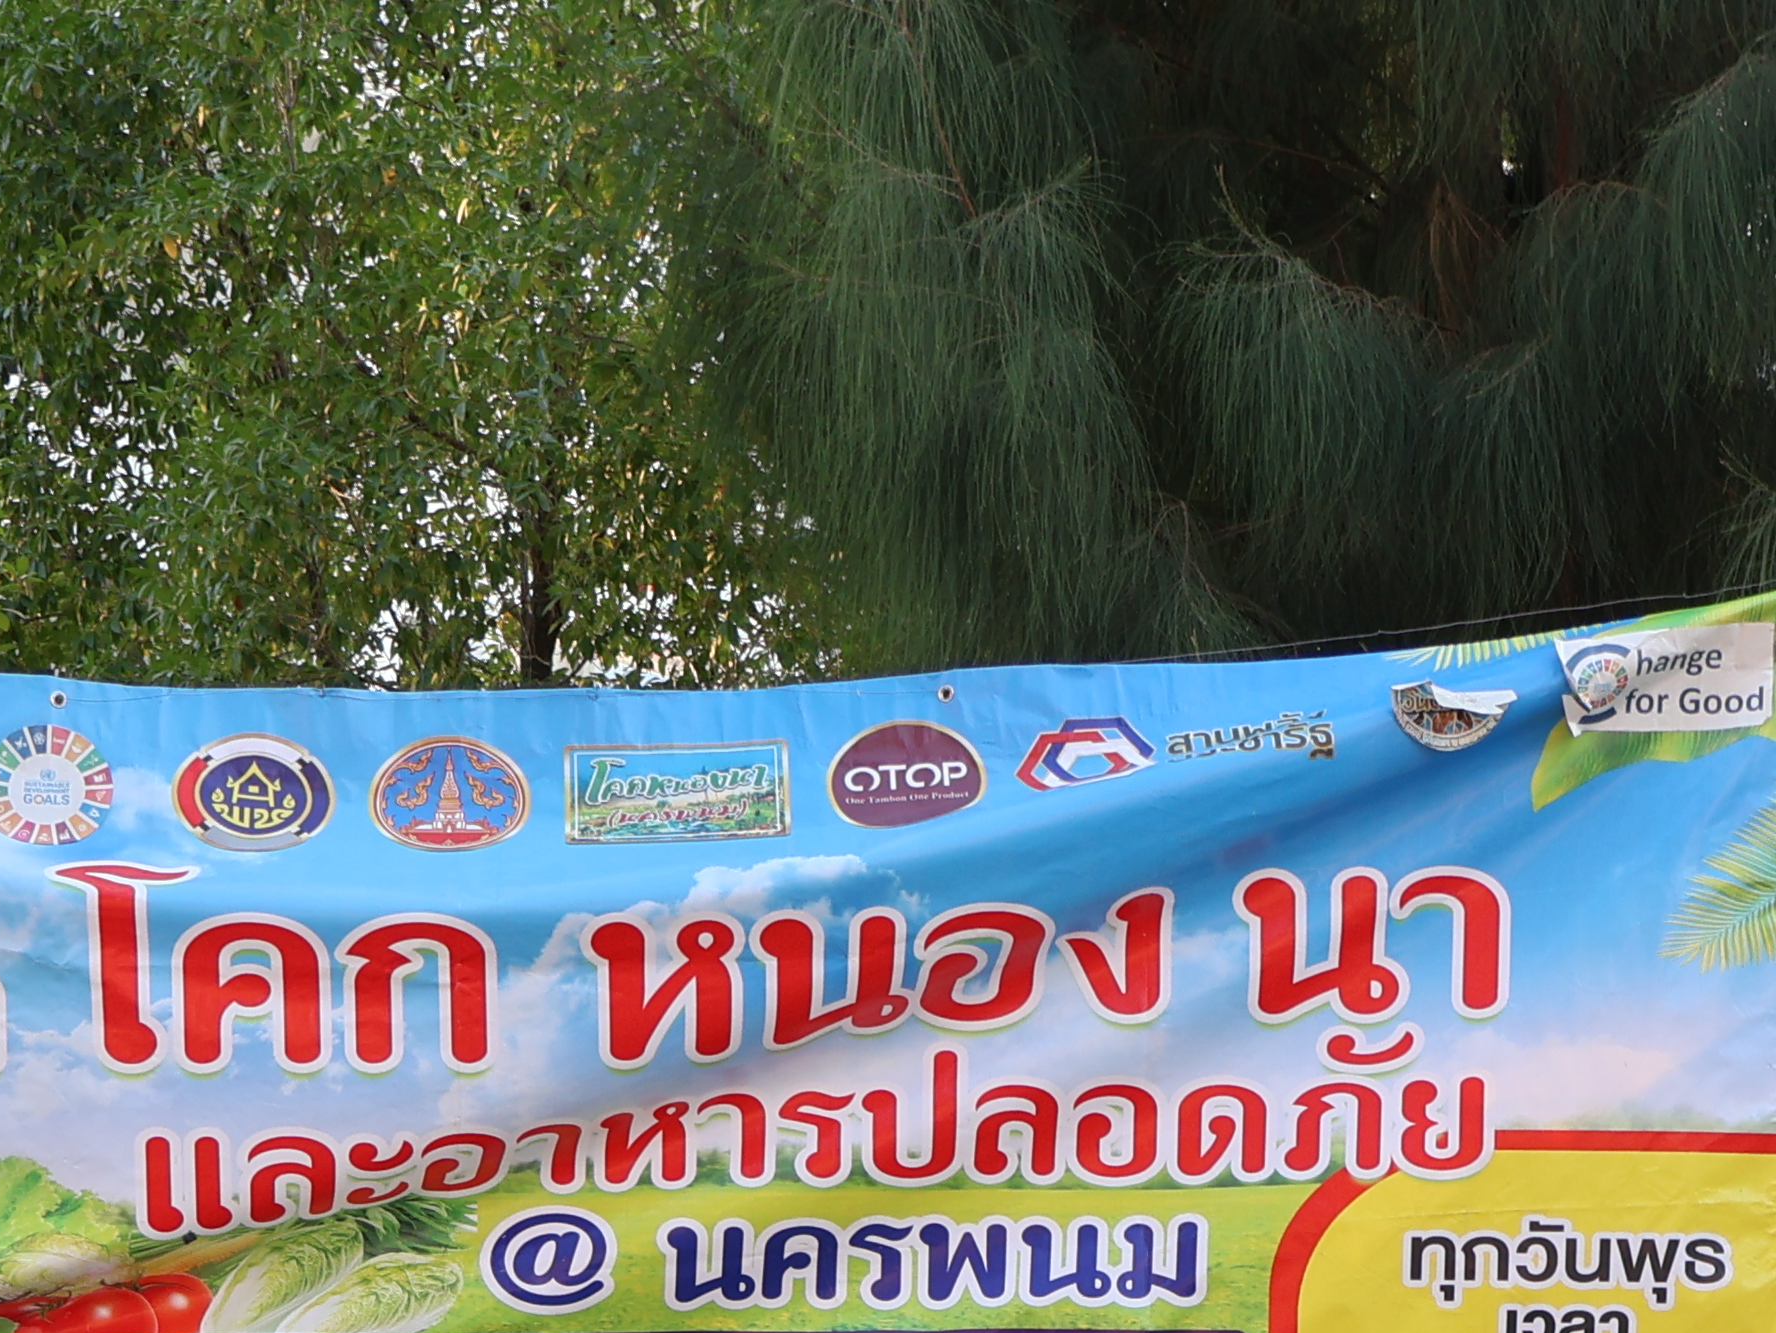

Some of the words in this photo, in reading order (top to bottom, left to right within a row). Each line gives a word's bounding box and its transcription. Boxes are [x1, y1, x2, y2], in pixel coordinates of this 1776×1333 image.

[1625, 688, 1669, 714] for
[1679, 686, 1764, 714] Good
[23, 793, 71, 805] GOALS
[844, 762, 968, 792] OTOP
[57, 867, 490, 1066] โคก
[591, 892, 1166, 1061] หนอง
[1243, 876, 1501, 1016] นา
[147, 1030, 1485, 1236] และอาหารปลอดภัย
[491, 1212, 606, 1306] @
[665, 1221, 1201, 1303] นครพนม
[1410, 1221, 1725, 1303] ทุกวันพุธ
